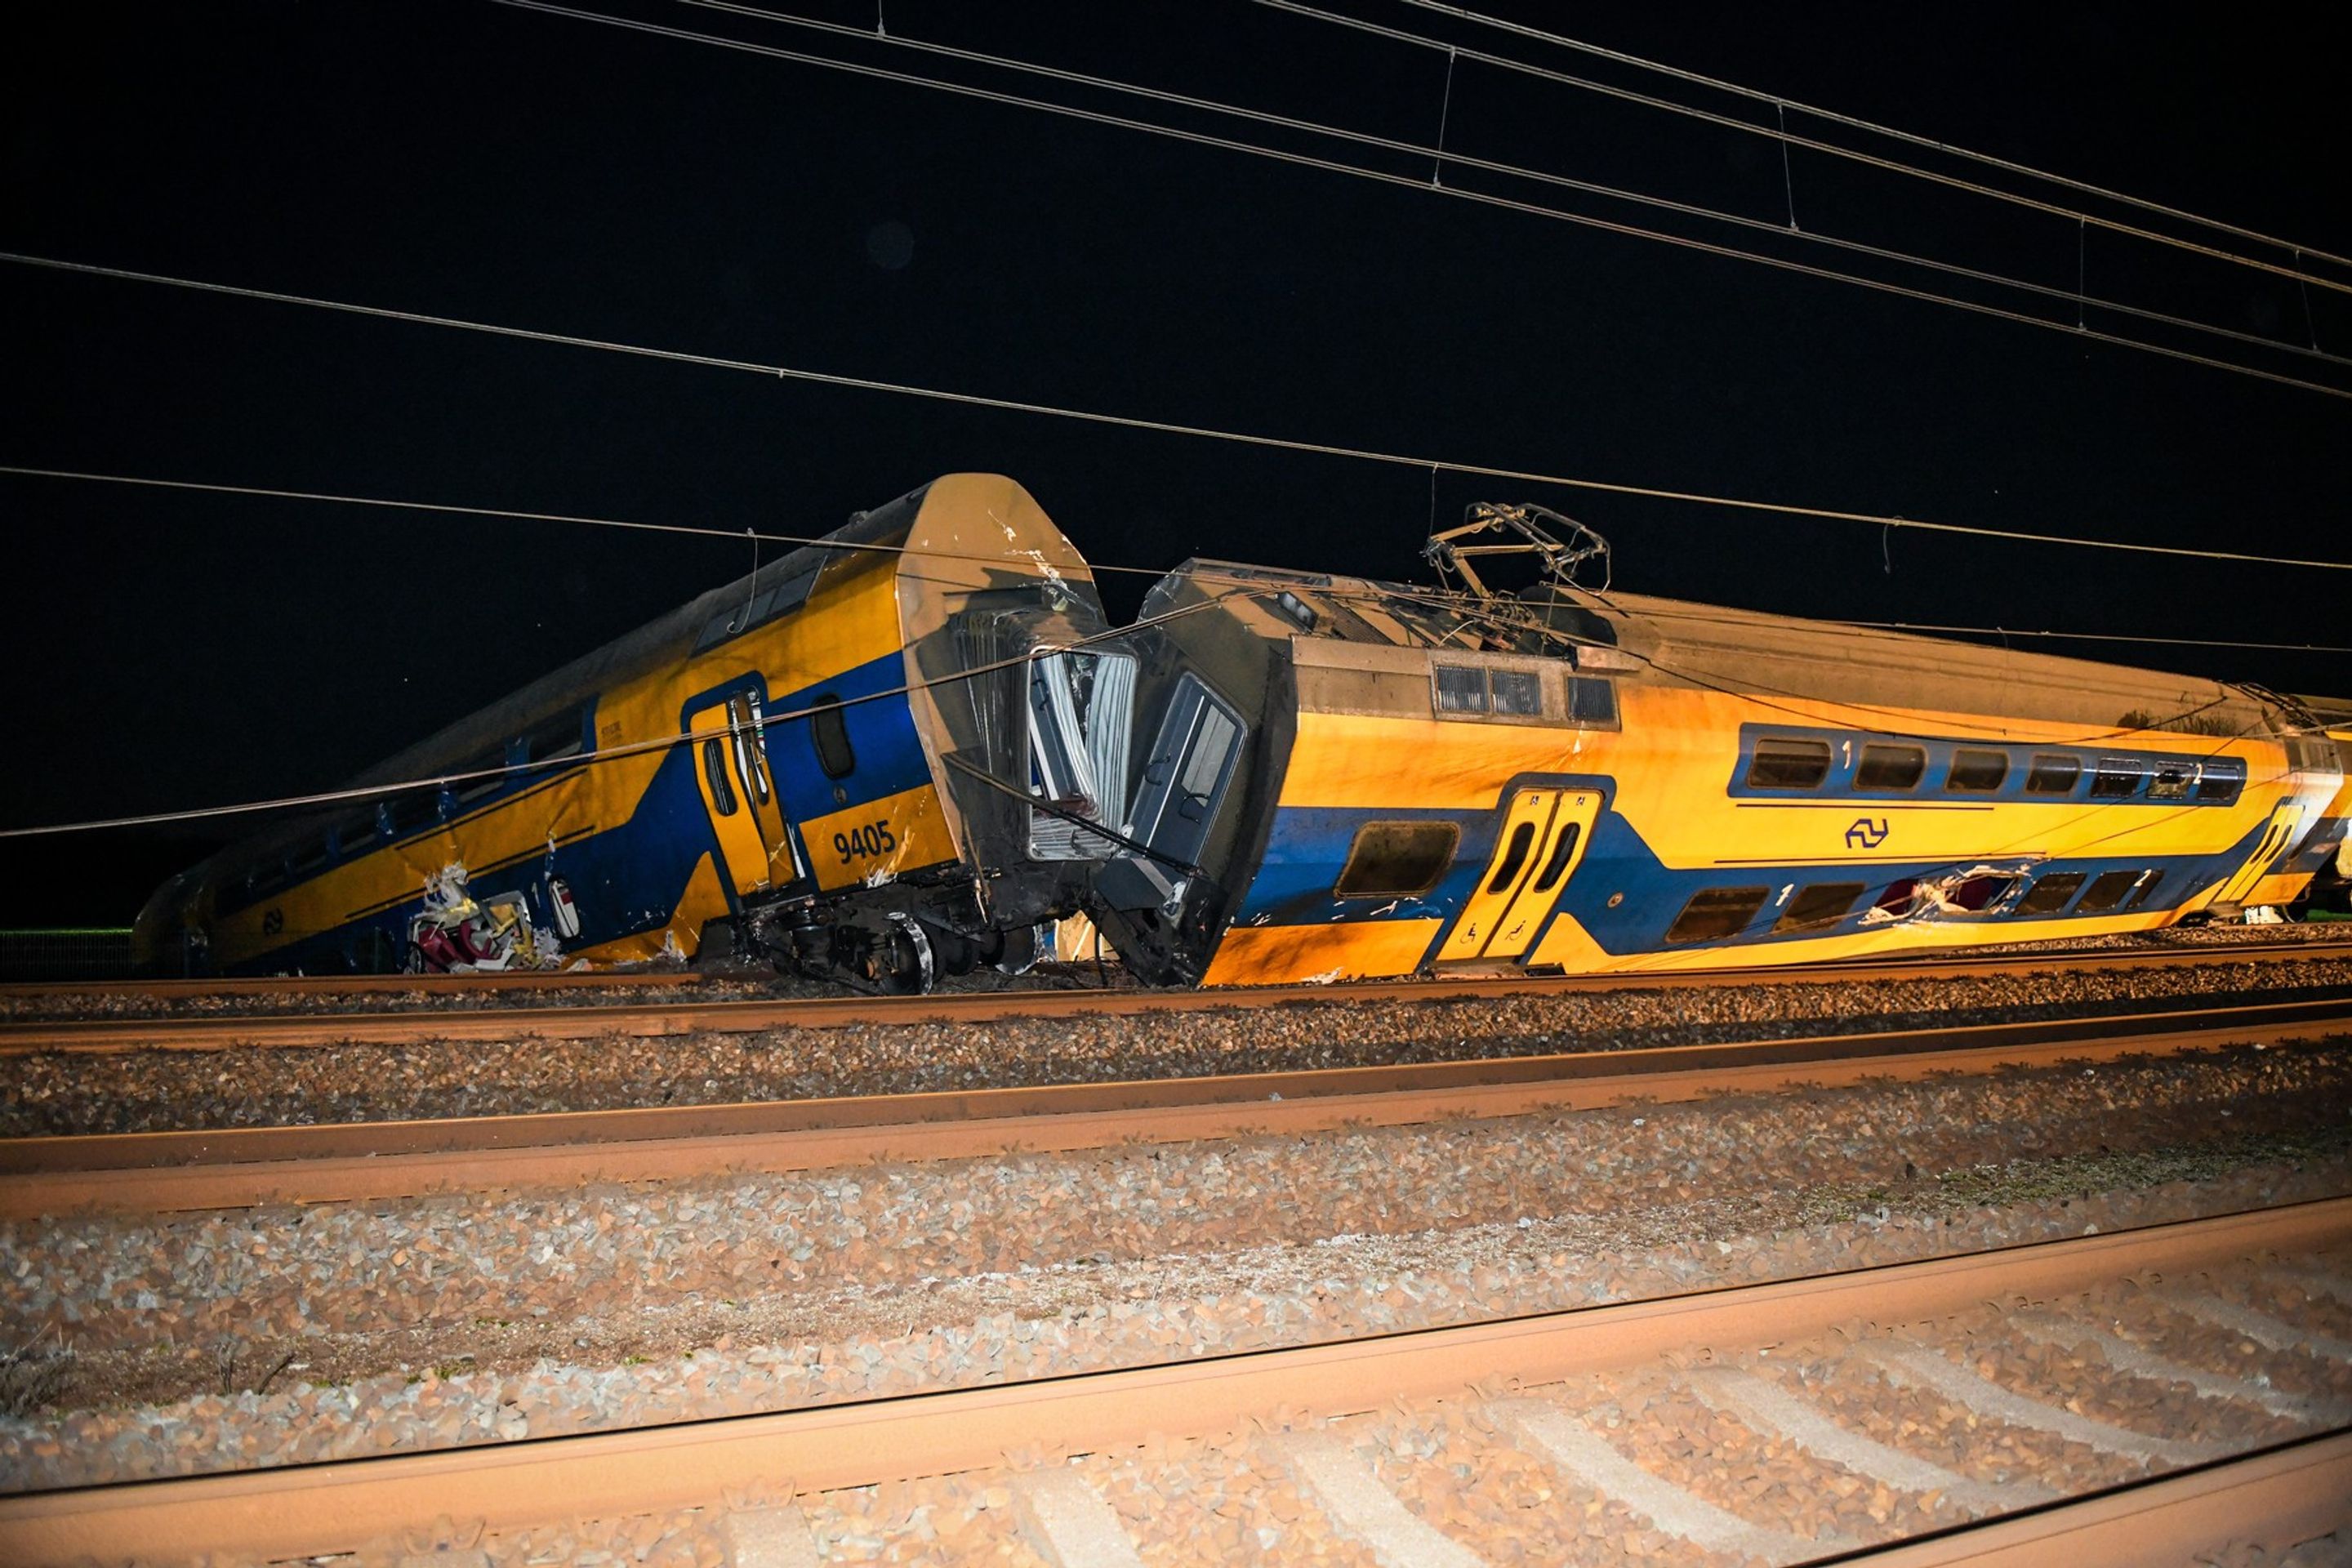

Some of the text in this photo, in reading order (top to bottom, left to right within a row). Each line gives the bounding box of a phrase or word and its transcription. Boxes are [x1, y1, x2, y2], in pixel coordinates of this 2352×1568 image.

[1842, 740, 1851, 769] 1
[2193, 762, 2203, 784] 2
[834, 819, 896, 864] 9405
[2133, 869, 2152, 887] 2
[1775, 884, 1794, 906] 1
